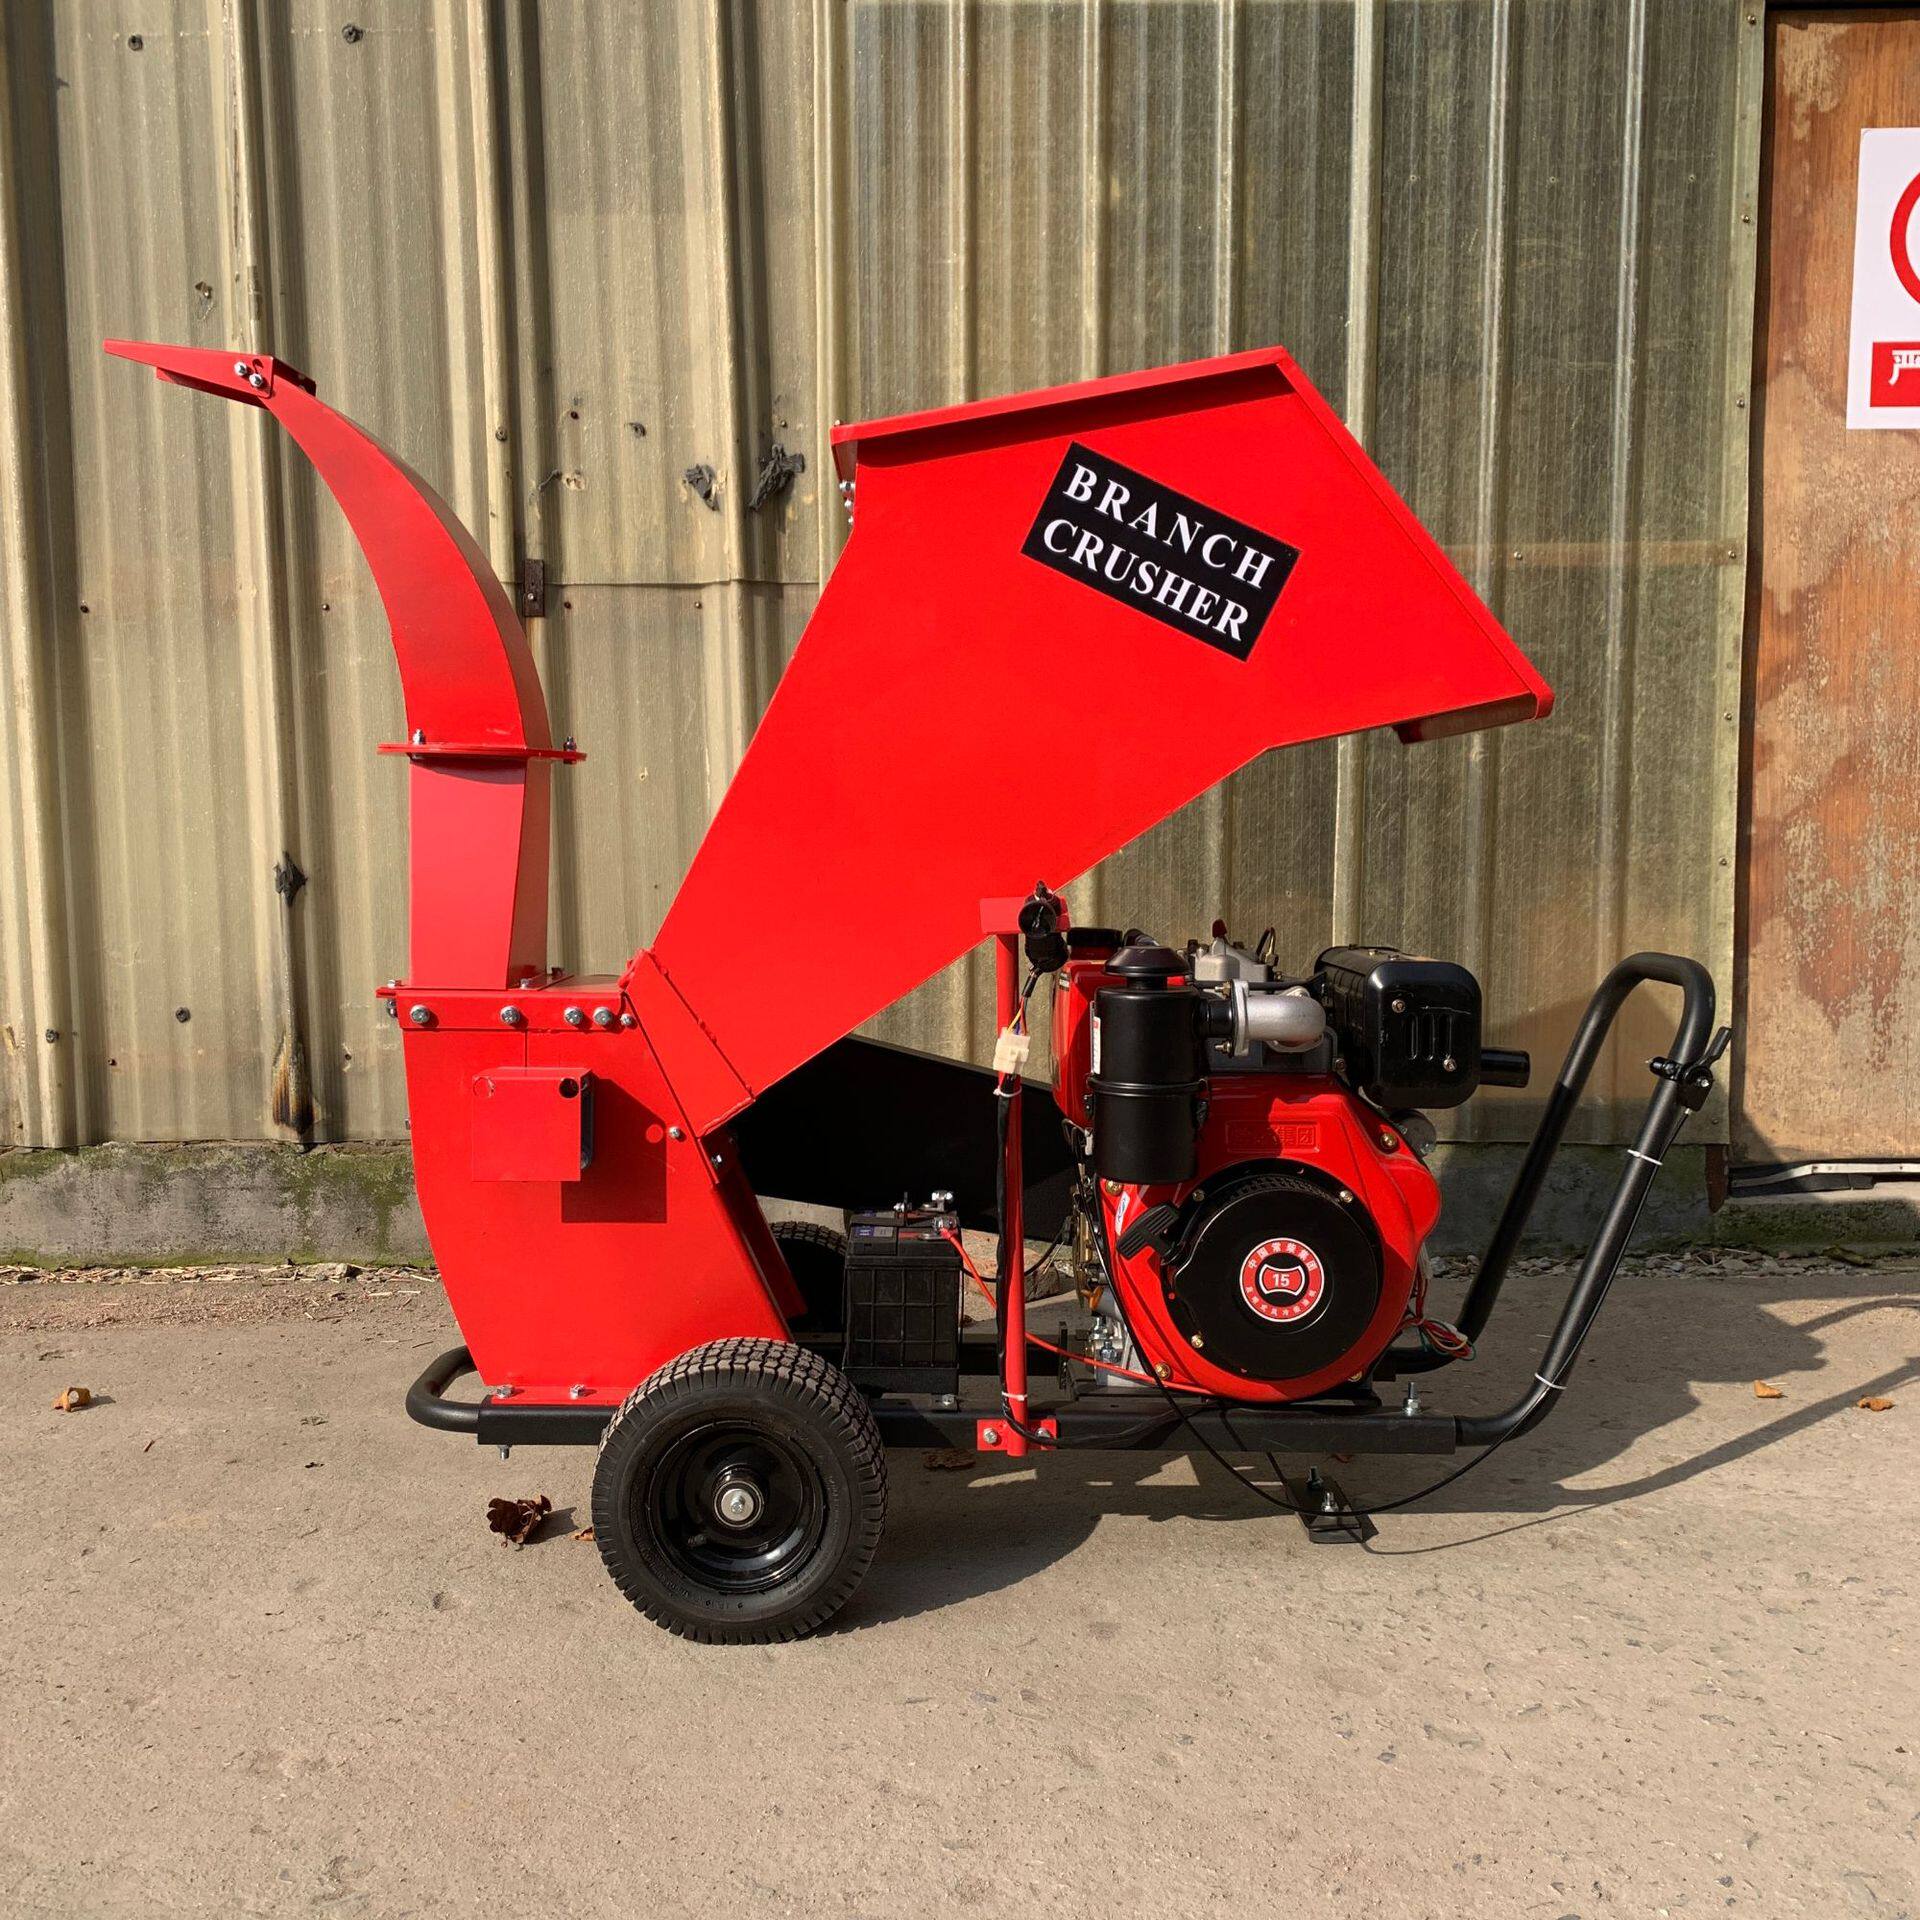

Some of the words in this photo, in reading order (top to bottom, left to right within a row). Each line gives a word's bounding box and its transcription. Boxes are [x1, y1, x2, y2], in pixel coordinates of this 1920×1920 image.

[1043, 519, 1249, 642] CRUSHER
[1062, 463, 1276, 589] BRANCH
[1272, 1273, 1291, 1288] 15
